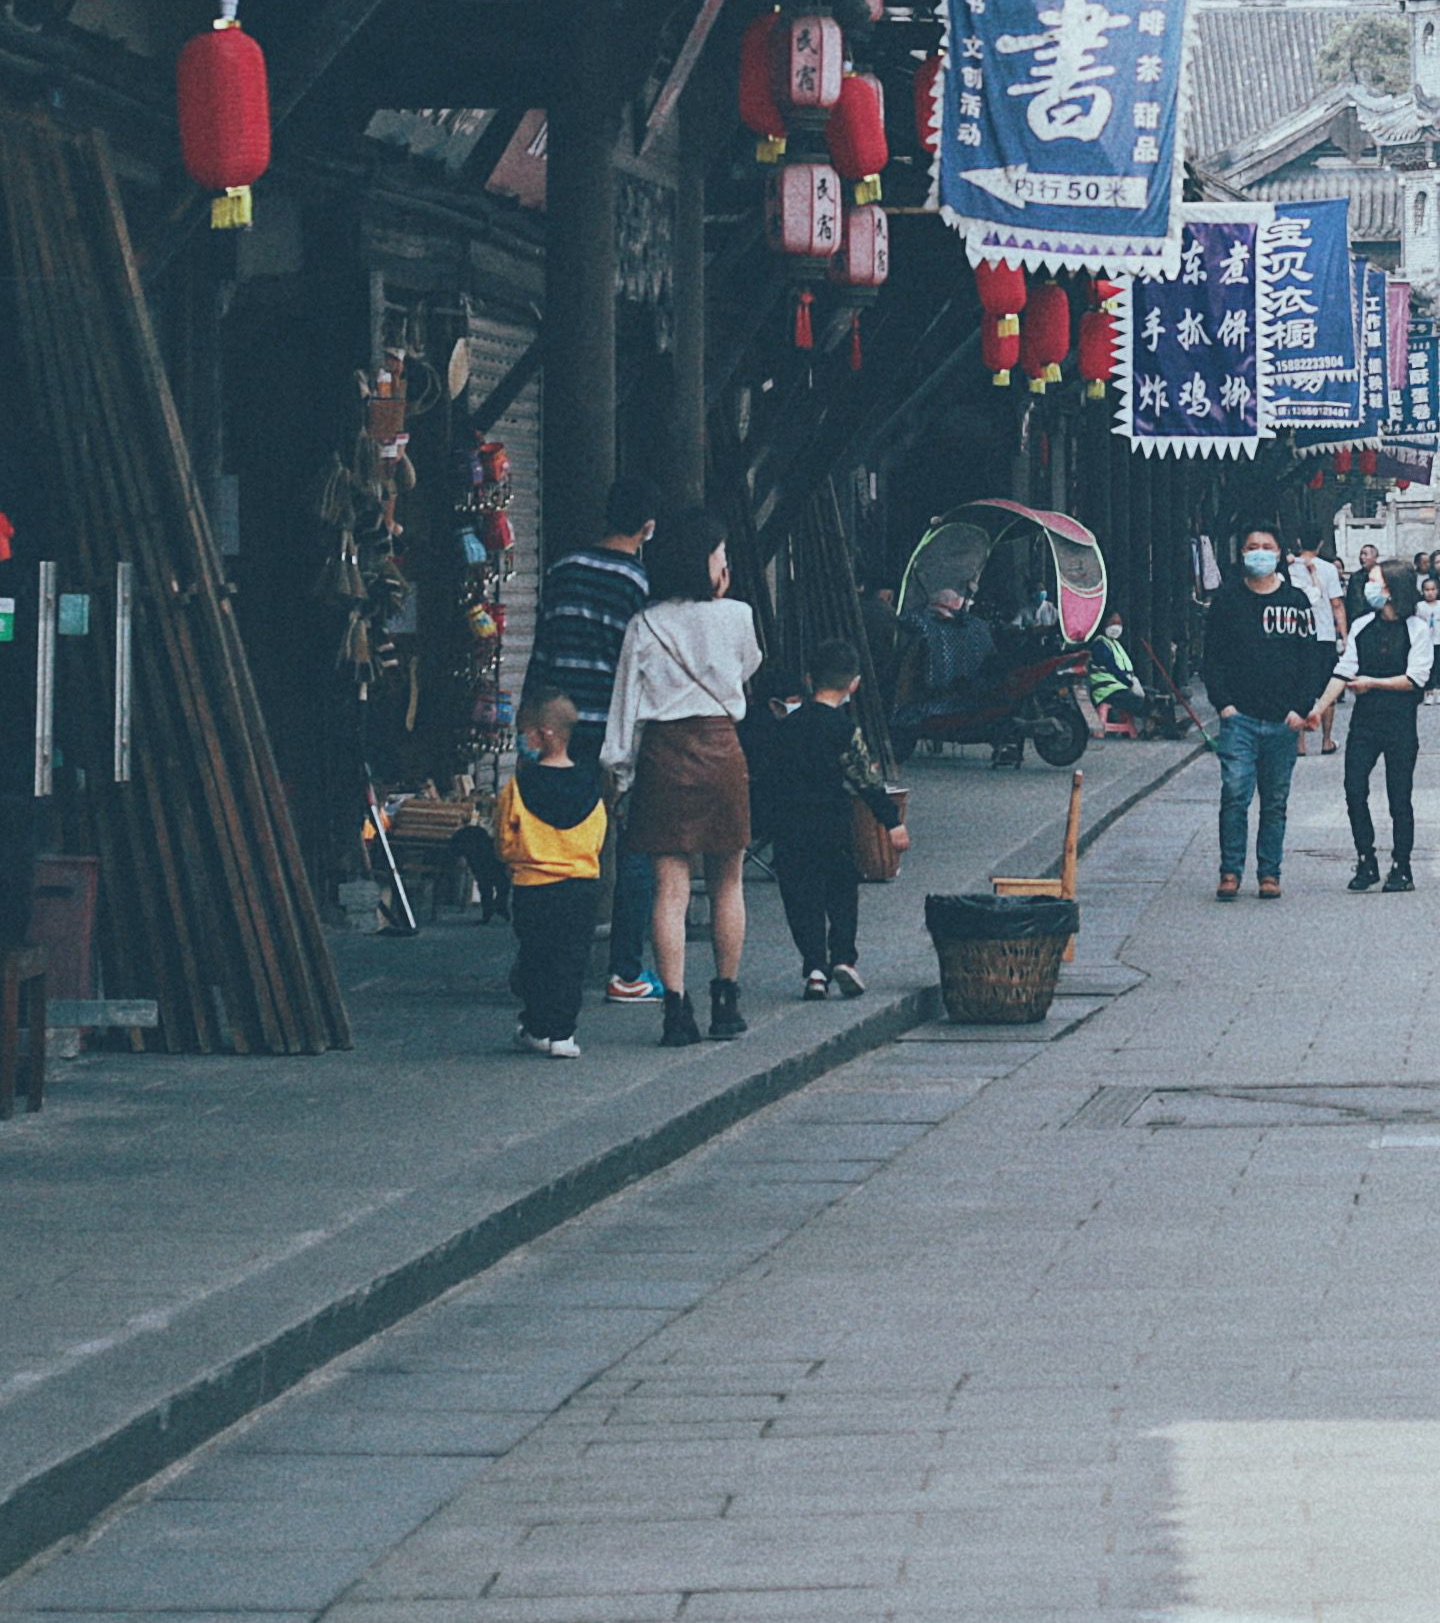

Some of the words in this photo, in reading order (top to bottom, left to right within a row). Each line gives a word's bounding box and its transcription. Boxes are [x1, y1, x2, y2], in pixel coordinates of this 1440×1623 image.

[795, 28, 818, 93] 民宿
[1132, 102, 1161, 163] 甜品
[815, 177, 835, 242] 民宿
[1014, 179, 1130, 207] 内行50米
[1263, 217, 1319, 350] 宝贝衣橱
[1140, 306, 1251, 354] 手抓饼
[1138, 371, 1252, 421] 炸鸡柳
